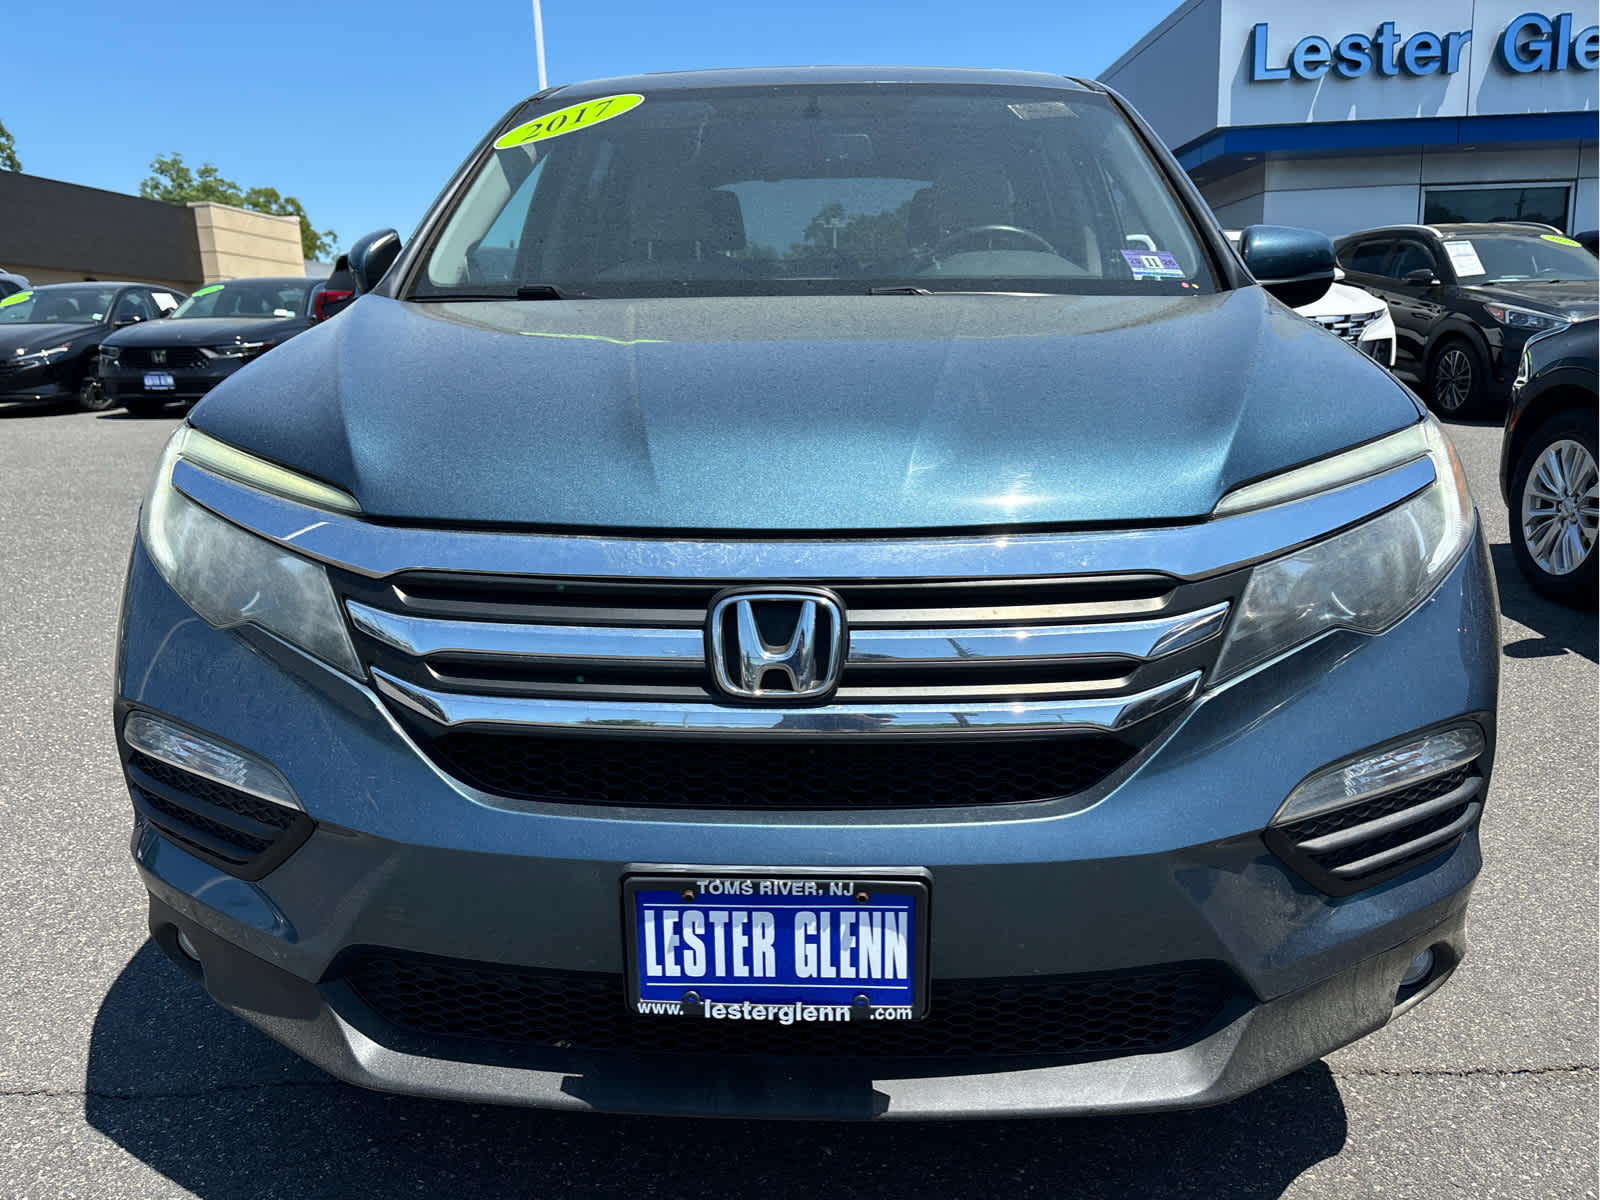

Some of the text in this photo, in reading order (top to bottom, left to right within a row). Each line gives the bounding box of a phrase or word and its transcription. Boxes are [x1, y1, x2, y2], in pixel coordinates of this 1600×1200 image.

[1252, 20, 1472, 80] Lester
[519, 98, 615, 142] 2017
[1144, 257, 1160, 267] 11
[696, 879, 855, 896] TOMS RIVER, NJ
[644, 909, 909, 980] LESTER GLENN
[638, 999, 913, 1026] www. lesterglenn .com
